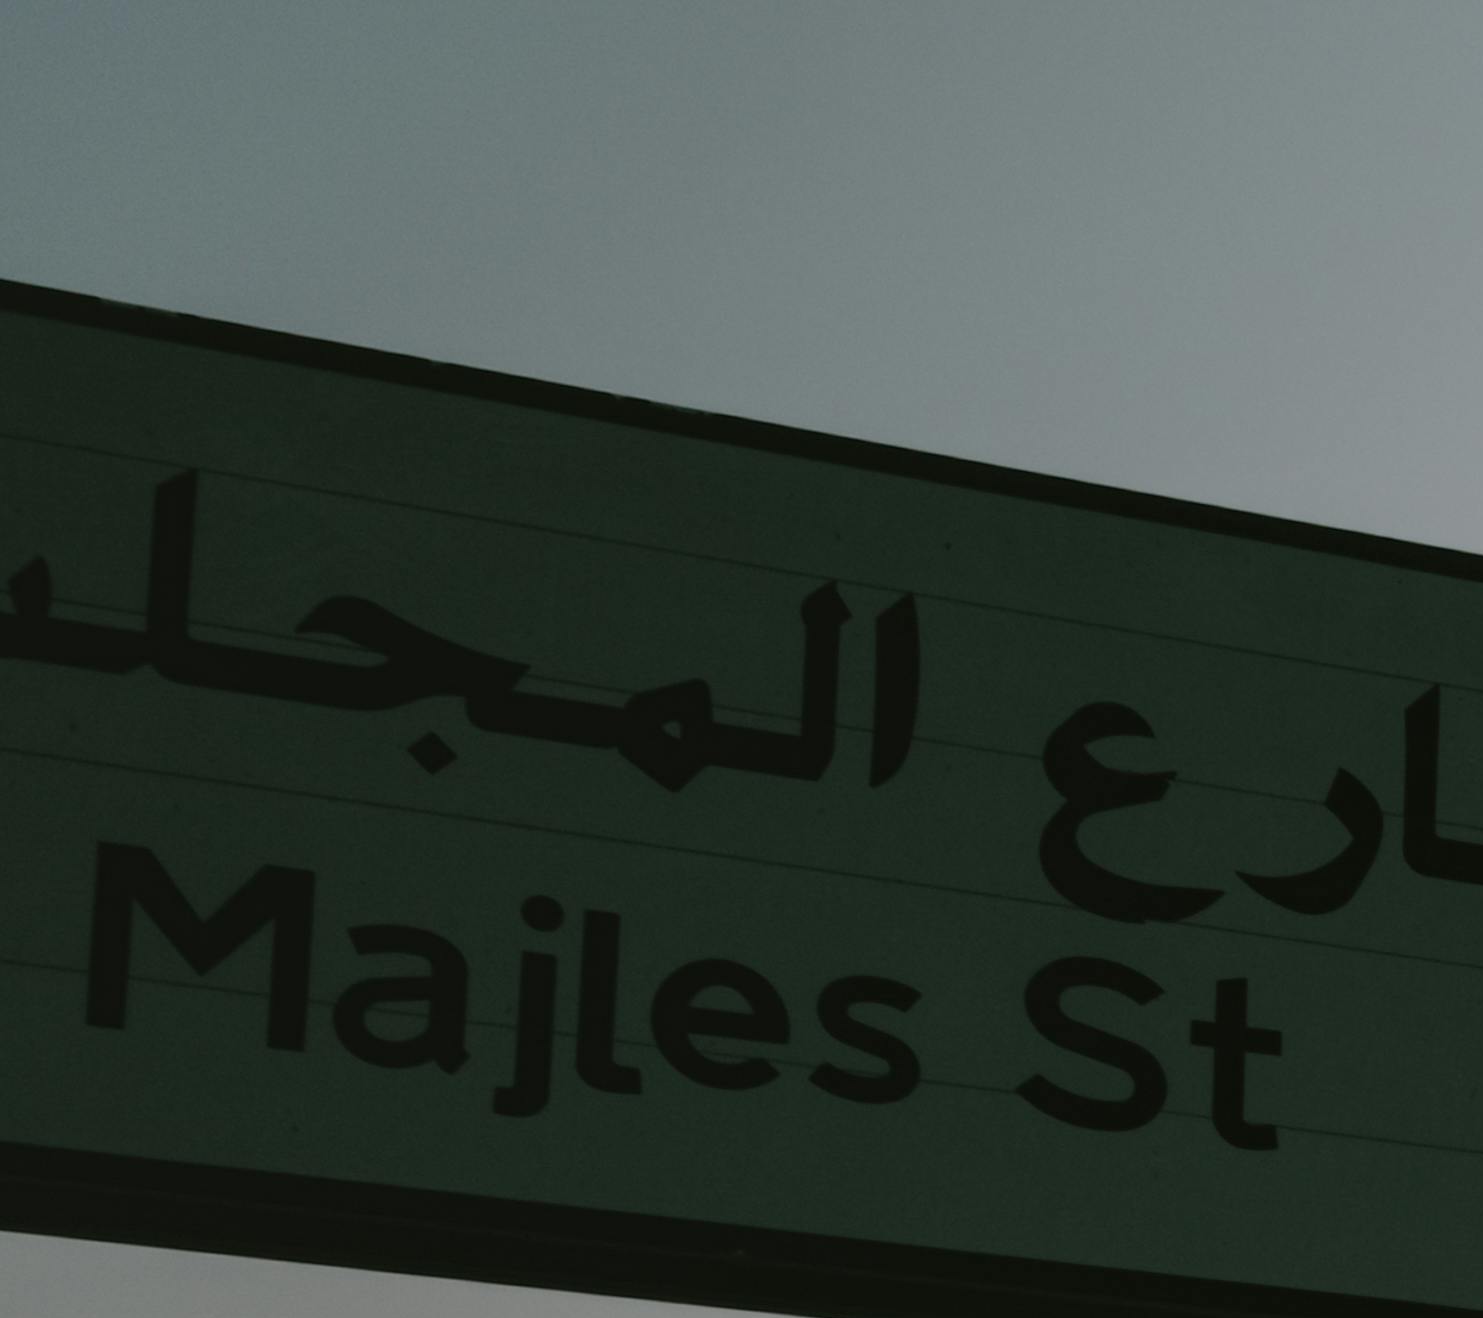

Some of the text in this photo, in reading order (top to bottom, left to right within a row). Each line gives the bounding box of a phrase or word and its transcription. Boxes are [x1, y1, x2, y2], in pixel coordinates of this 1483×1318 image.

[0, 469, 921, 793] المجل
[83, 840, 1285, 1154] Majles St
